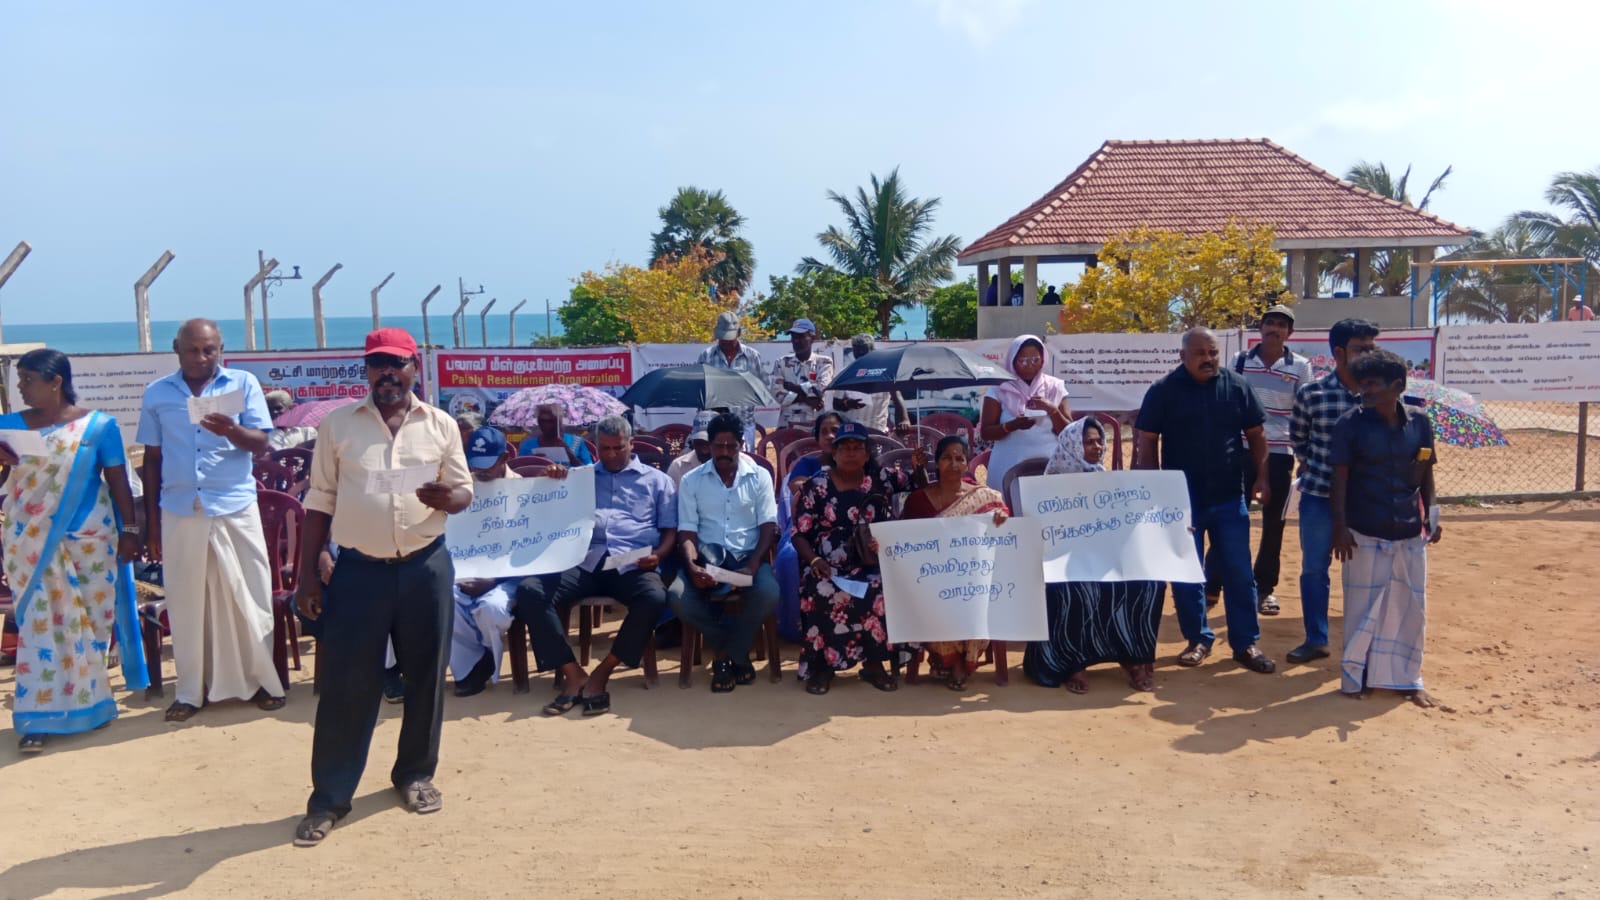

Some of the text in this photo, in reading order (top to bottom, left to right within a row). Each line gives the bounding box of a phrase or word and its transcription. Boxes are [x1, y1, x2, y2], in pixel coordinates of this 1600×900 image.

[269, 363, 303, 381] ஆட்சி
[445, 355, 624, 374] பலாலி மீள்குடியேற்ற அமைப்பு
[487, 373, 554, 385] Resettlement
[558, 373, 620, 385] Organization
[298, 382, 371, 399] காணிகளு
[464, 491, 508, 513] ங்கள்
[1037, 485, 1151, 514] எங்கள் முற்றம்
[477, 515, 530, 538] நீங்கள்
[1124, 506, 1184, 528] வேண்டும்
[885, 539, 941, 560] எத்தனை
[916, 556, 995, 584] நிலமிழந்து
